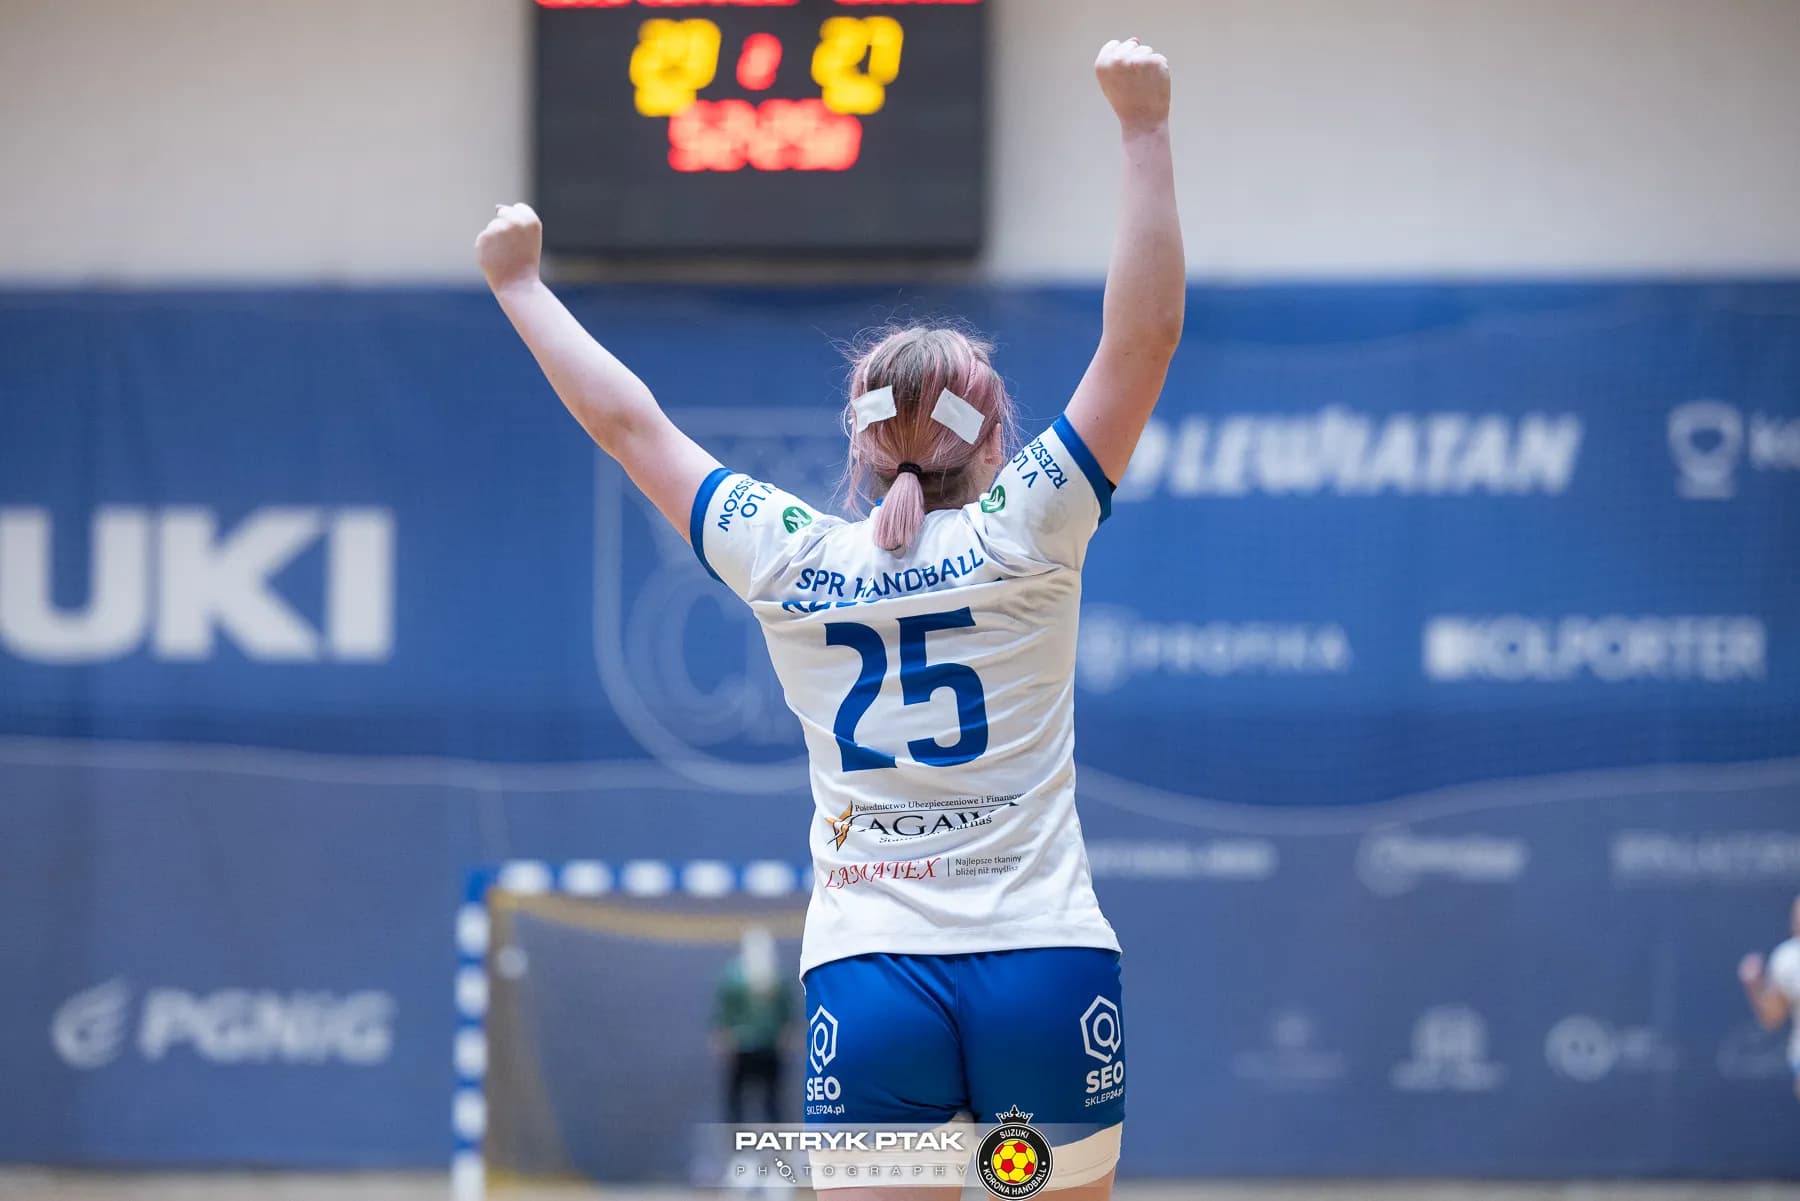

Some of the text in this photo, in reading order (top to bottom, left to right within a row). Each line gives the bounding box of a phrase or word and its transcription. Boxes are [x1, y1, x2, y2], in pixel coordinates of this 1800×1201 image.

[1022, 470, 1038, 488] V
[740, 494, 766, 518] LO
[797, 548, 984, 599] SPR HANDBALL
[1440, 616, 1767, 680] KOLPORTER
[824, 606, 989, 772] 25
[855, 803, 906, 812] Pośrednictwo
[908, 798, 979, 809] Ubezpieczeniowe
[981, 796, 985, 804] i
[825, 857, 941, 889] LAMATEX
[955, 855, 1022, 867] Najlepsze tkaniny
[955, 867, 976, 877] bliżej
[806, 1076, 841, 1102] SEO
[1085, 1060, 1124, 1094] SEO
[806, 1104, 845, 1115] SKLEP24.pl
